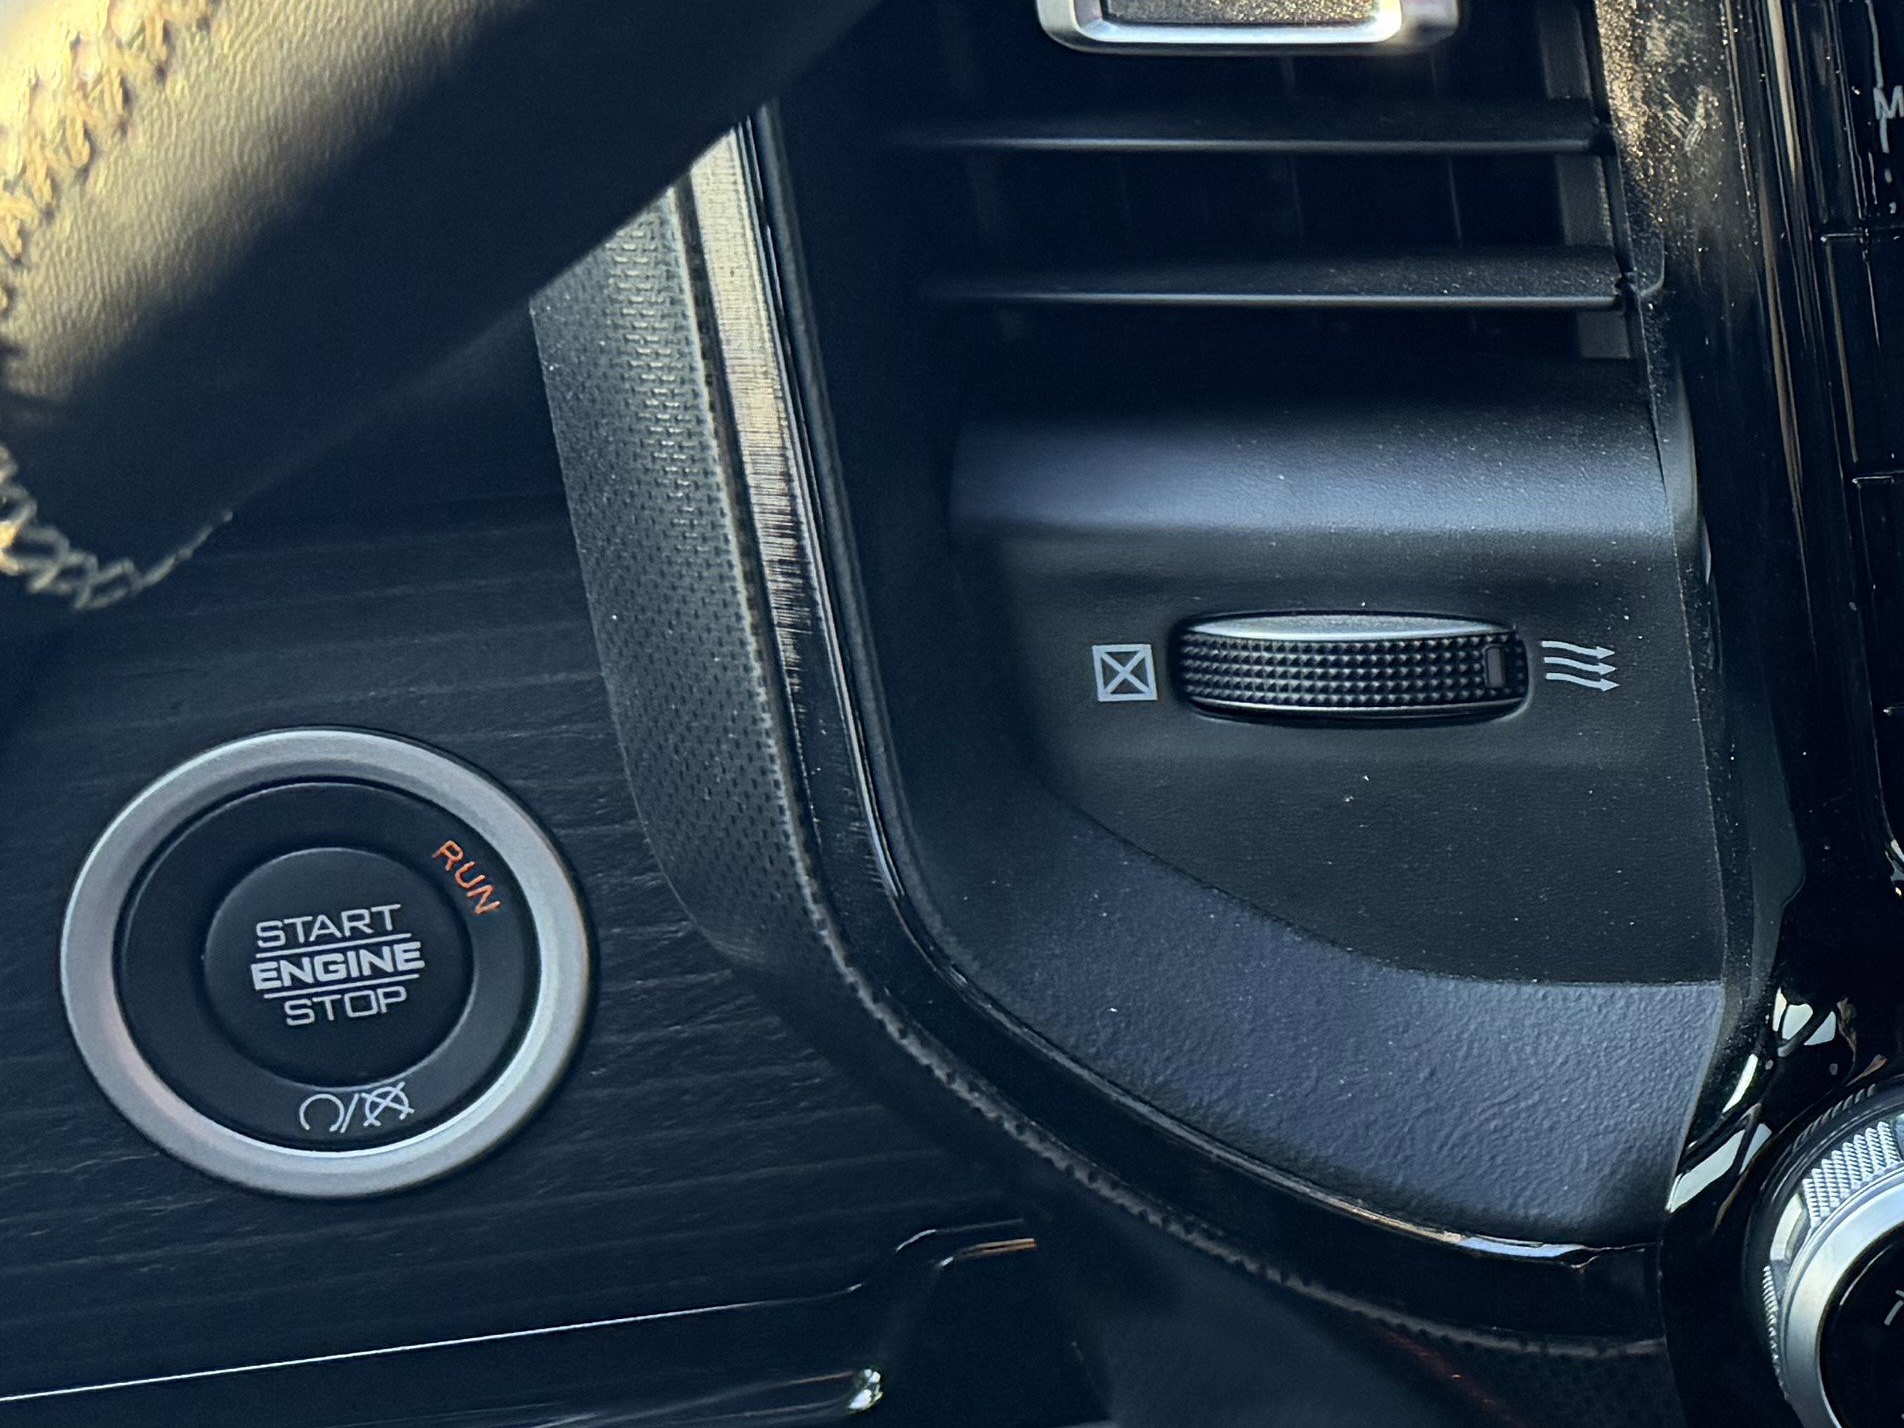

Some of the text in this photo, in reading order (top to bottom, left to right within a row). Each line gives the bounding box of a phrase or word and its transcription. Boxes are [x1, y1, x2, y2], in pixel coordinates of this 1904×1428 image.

[431, 839, 500, 915] RUN
[256, 903, 401, 949] START
[250, 940, 425, 991] ENGINE
[284, 984, 408, 1027] STOP
